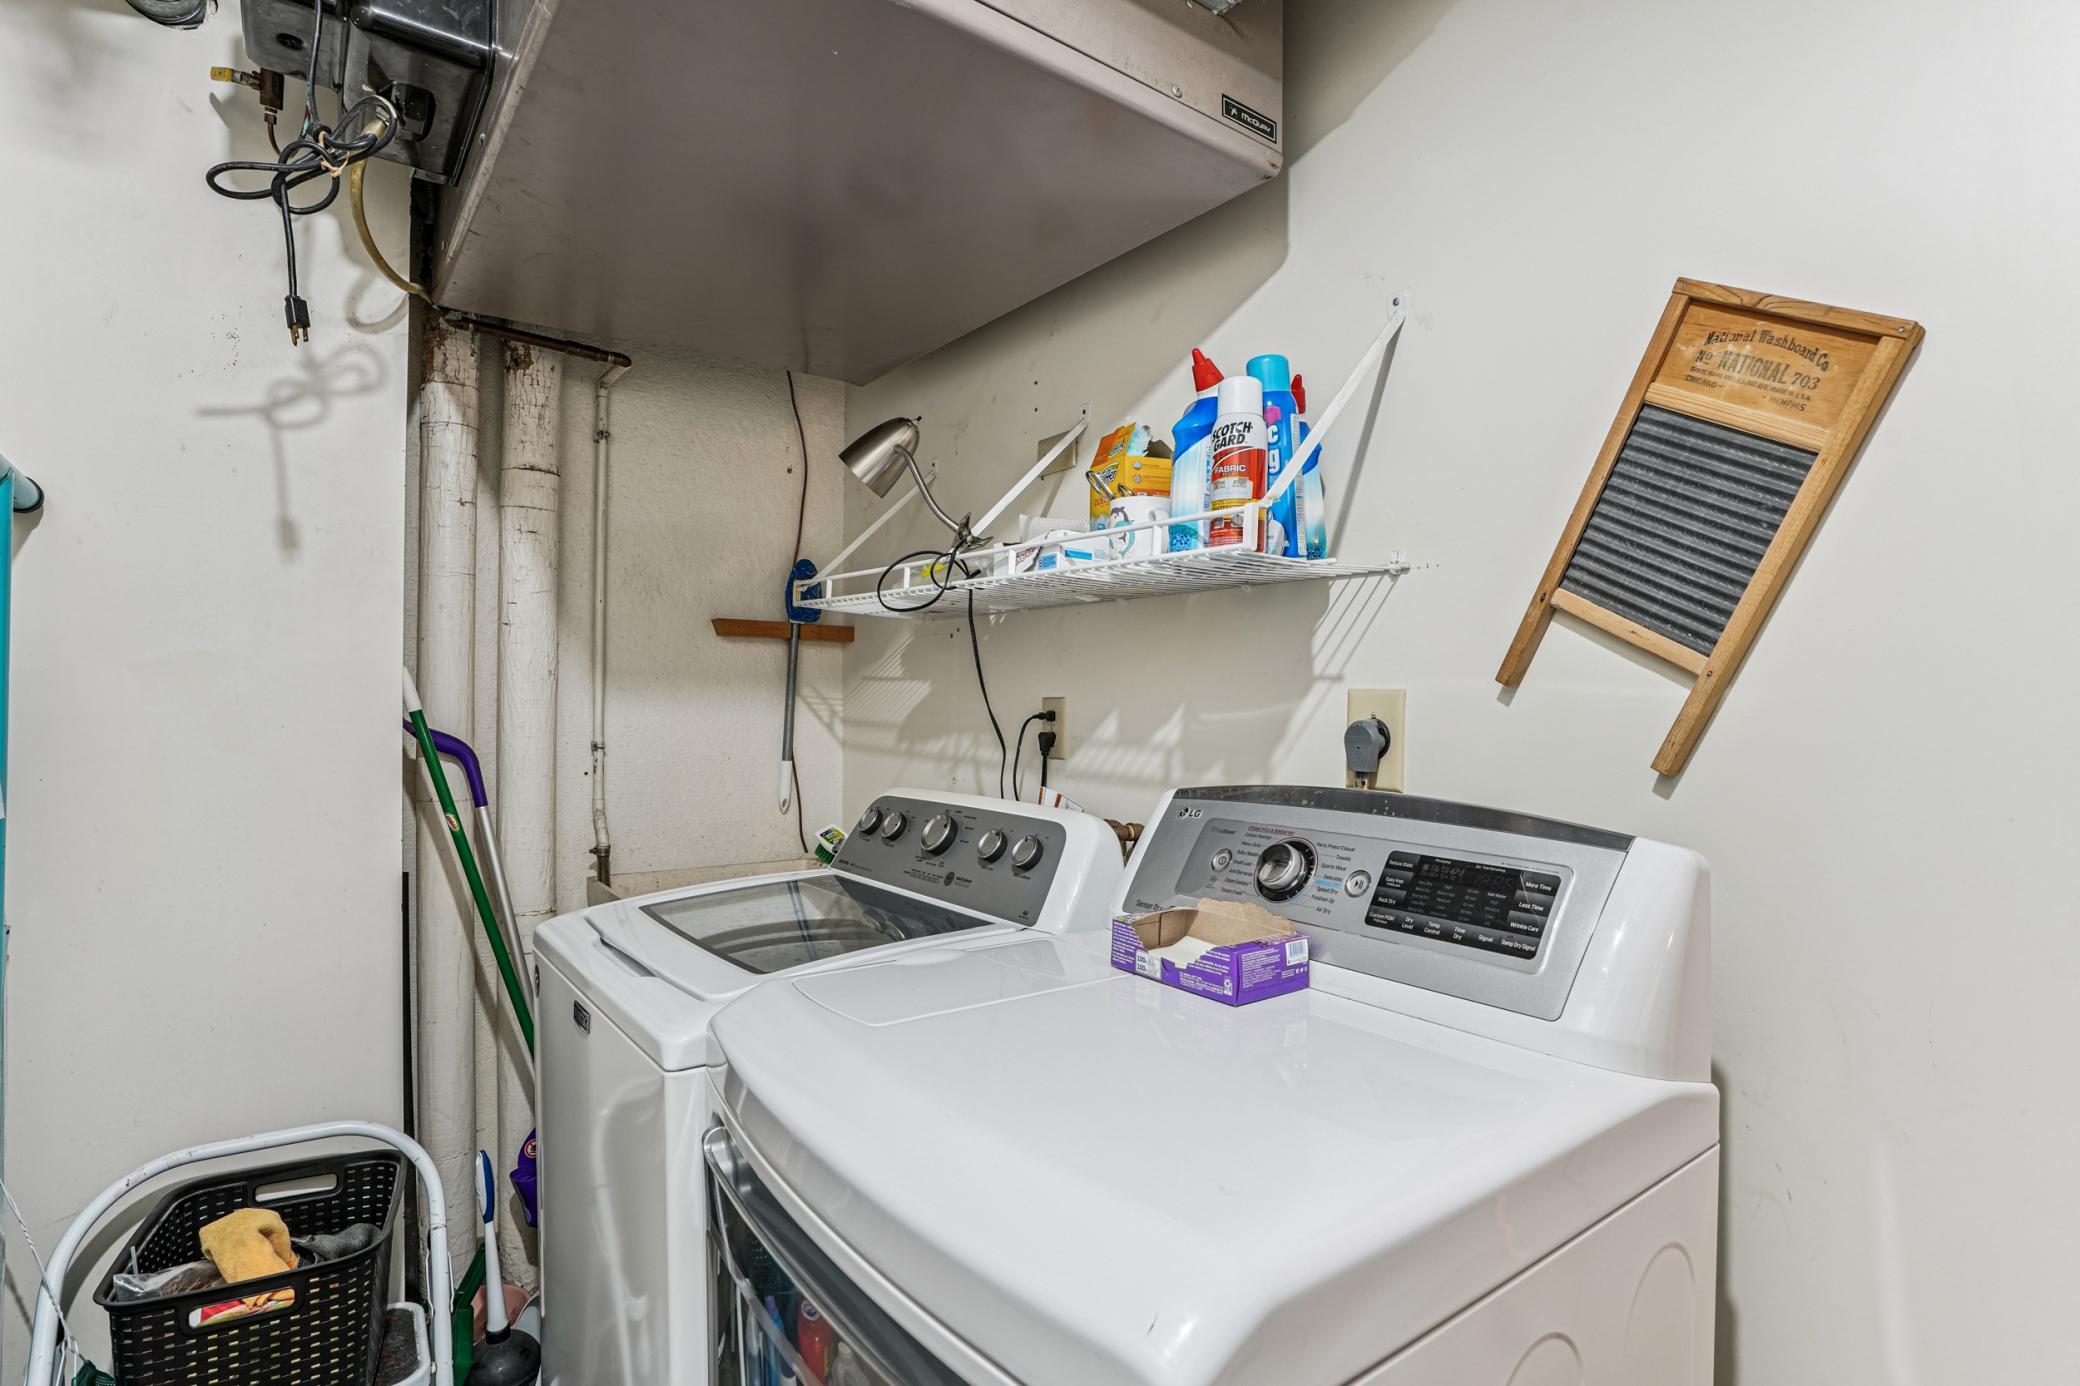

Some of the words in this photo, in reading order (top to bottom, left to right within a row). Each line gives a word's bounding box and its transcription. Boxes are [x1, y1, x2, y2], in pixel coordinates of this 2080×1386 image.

[1758, 329, 1819, 362] Washboard
[1717, 350, 1791, 384] NATIONAL
[1790, 371, 1821, 390] 703
[1213, 434, 1247, 452] GARD
[1214, 464, 1246, 474] FABRIC
[1525, 881, 1539, 889] More
[1518, 901, 1531, 909] Less
[1510, 921, 1527, 930] Wrinkle
[1424, 927, 1441, 935] Control
[1453, 933, 1463, 941] Dry
[1478, 934, 1494, 943] Signal
[1501, 939, 1514, 947] Damp
[1514, 941, 1522, 949] Dry
[1522, 943, 1537, 952] Signal
